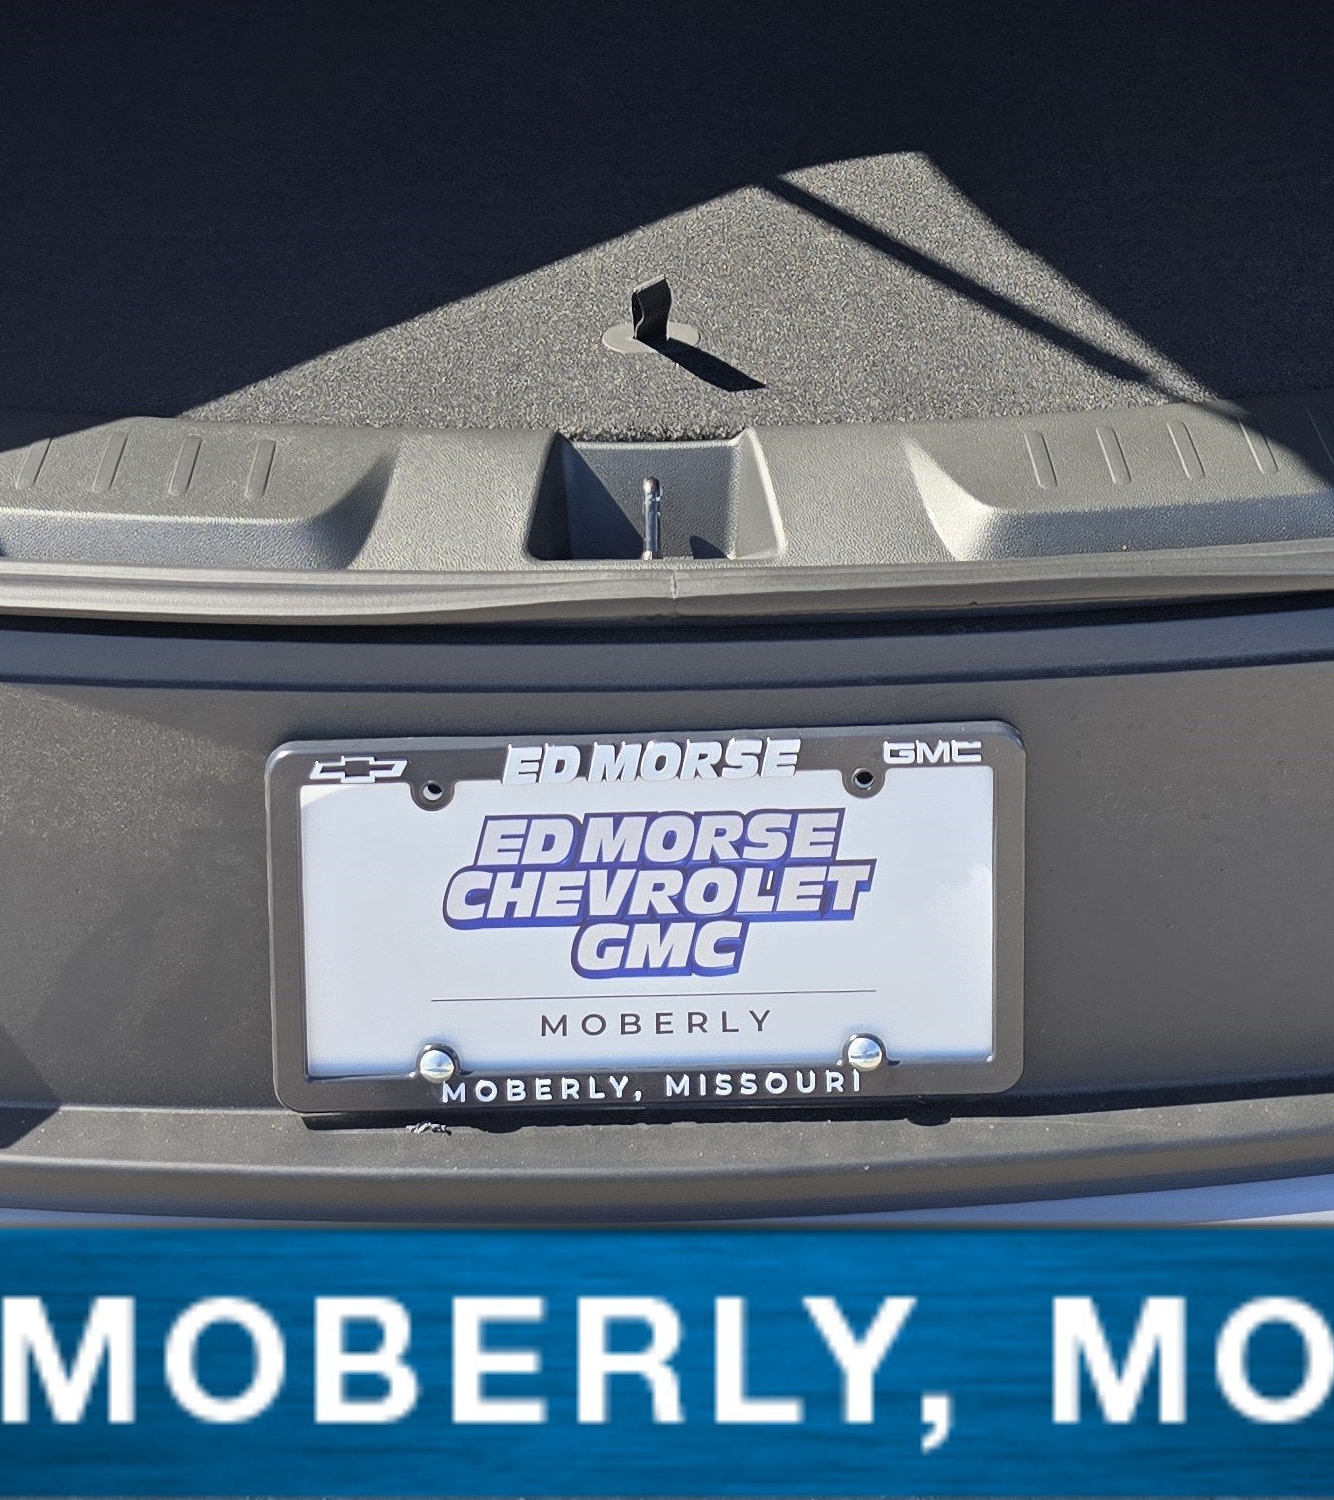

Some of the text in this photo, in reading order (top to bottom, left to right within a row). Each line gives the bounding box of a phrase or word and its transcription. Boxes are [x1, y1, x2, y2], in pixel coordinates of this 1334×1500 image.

[502, 737, 802, 785] ED MORSE
[883, 739, 983, 765] GMC
[474, 809, 841, 867] ED MORSE
[444, 862, 875, 924] CHEVROLET
[573, 919, 747, 974] GMC
[540, 1009, 772, 1037] MOBERLY
[441, 1068, 862, 1103] MOBERLY, MISSOURI
